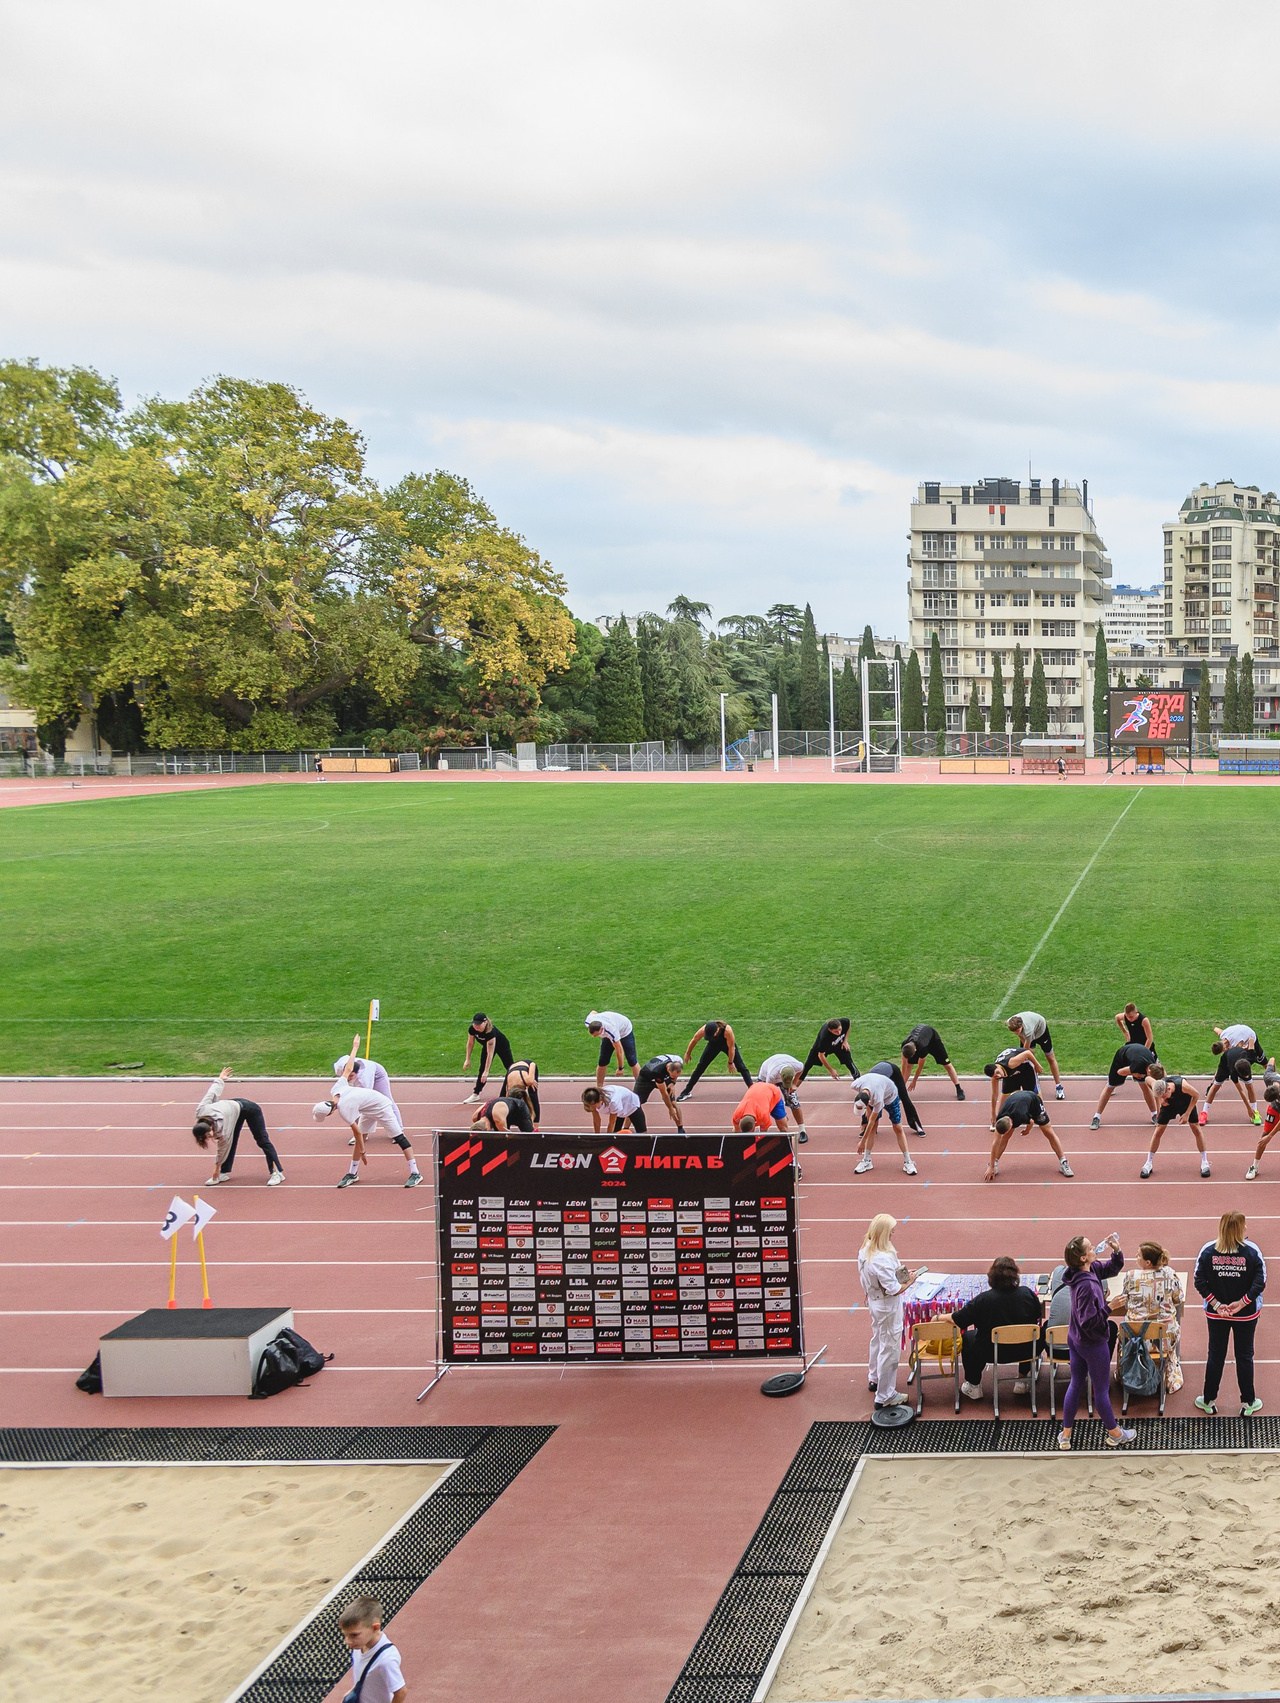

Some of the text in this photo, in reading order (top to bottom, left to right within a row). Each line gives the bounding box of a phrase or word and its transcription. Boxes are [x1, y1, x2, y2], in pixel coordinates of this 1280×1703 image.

[1147, 694, 1185, 712] СТУД
[1149, 708, 1170, 724] ЗА
[1148, 723, 1176, 739] БЕГ
[530, 1153, 724, 1170] LEON 2 ЛИГА Б
